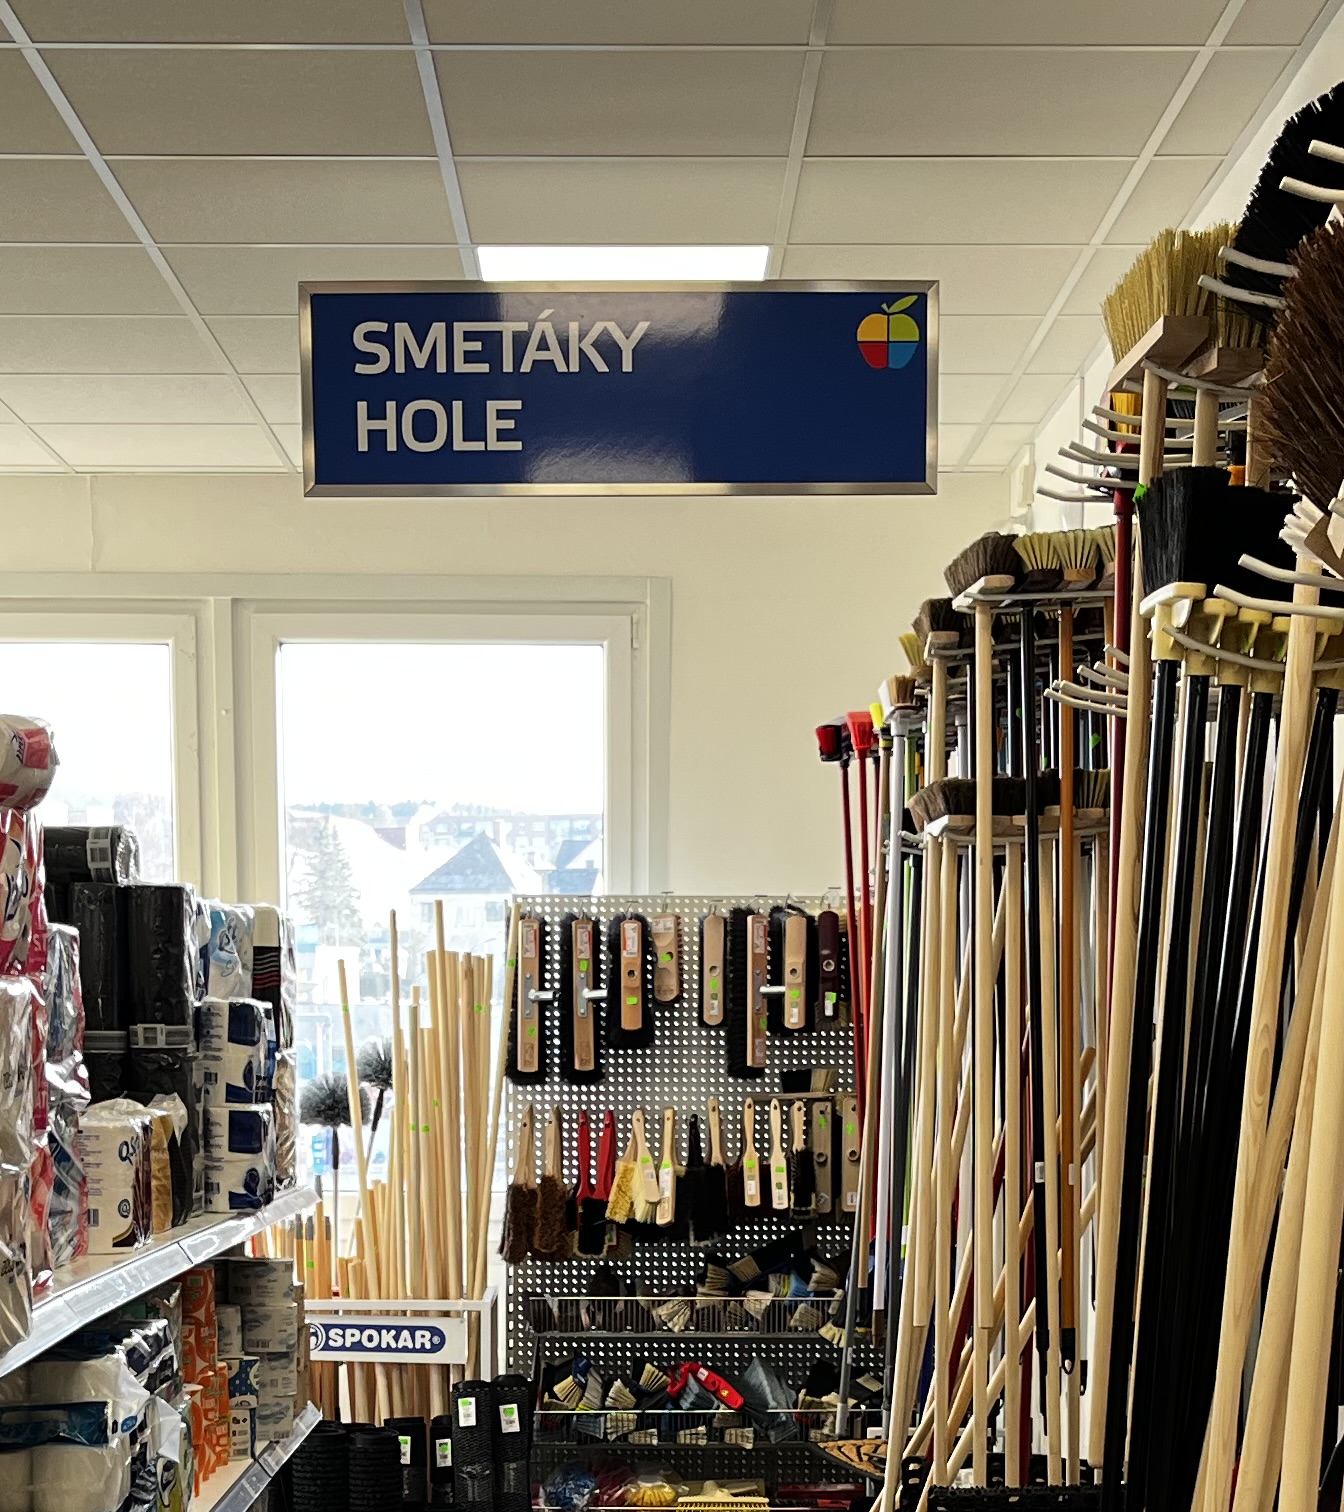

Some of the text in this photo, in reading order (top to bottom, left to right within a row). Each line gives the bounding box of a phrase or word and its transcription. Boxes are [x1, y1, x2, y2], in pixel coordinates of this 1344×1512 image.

[353, 310, 651, 375] SMETÁKY
[357, 399, 524, 453] HOLE
[328, 1328, 432, 1350] SPOKAR
